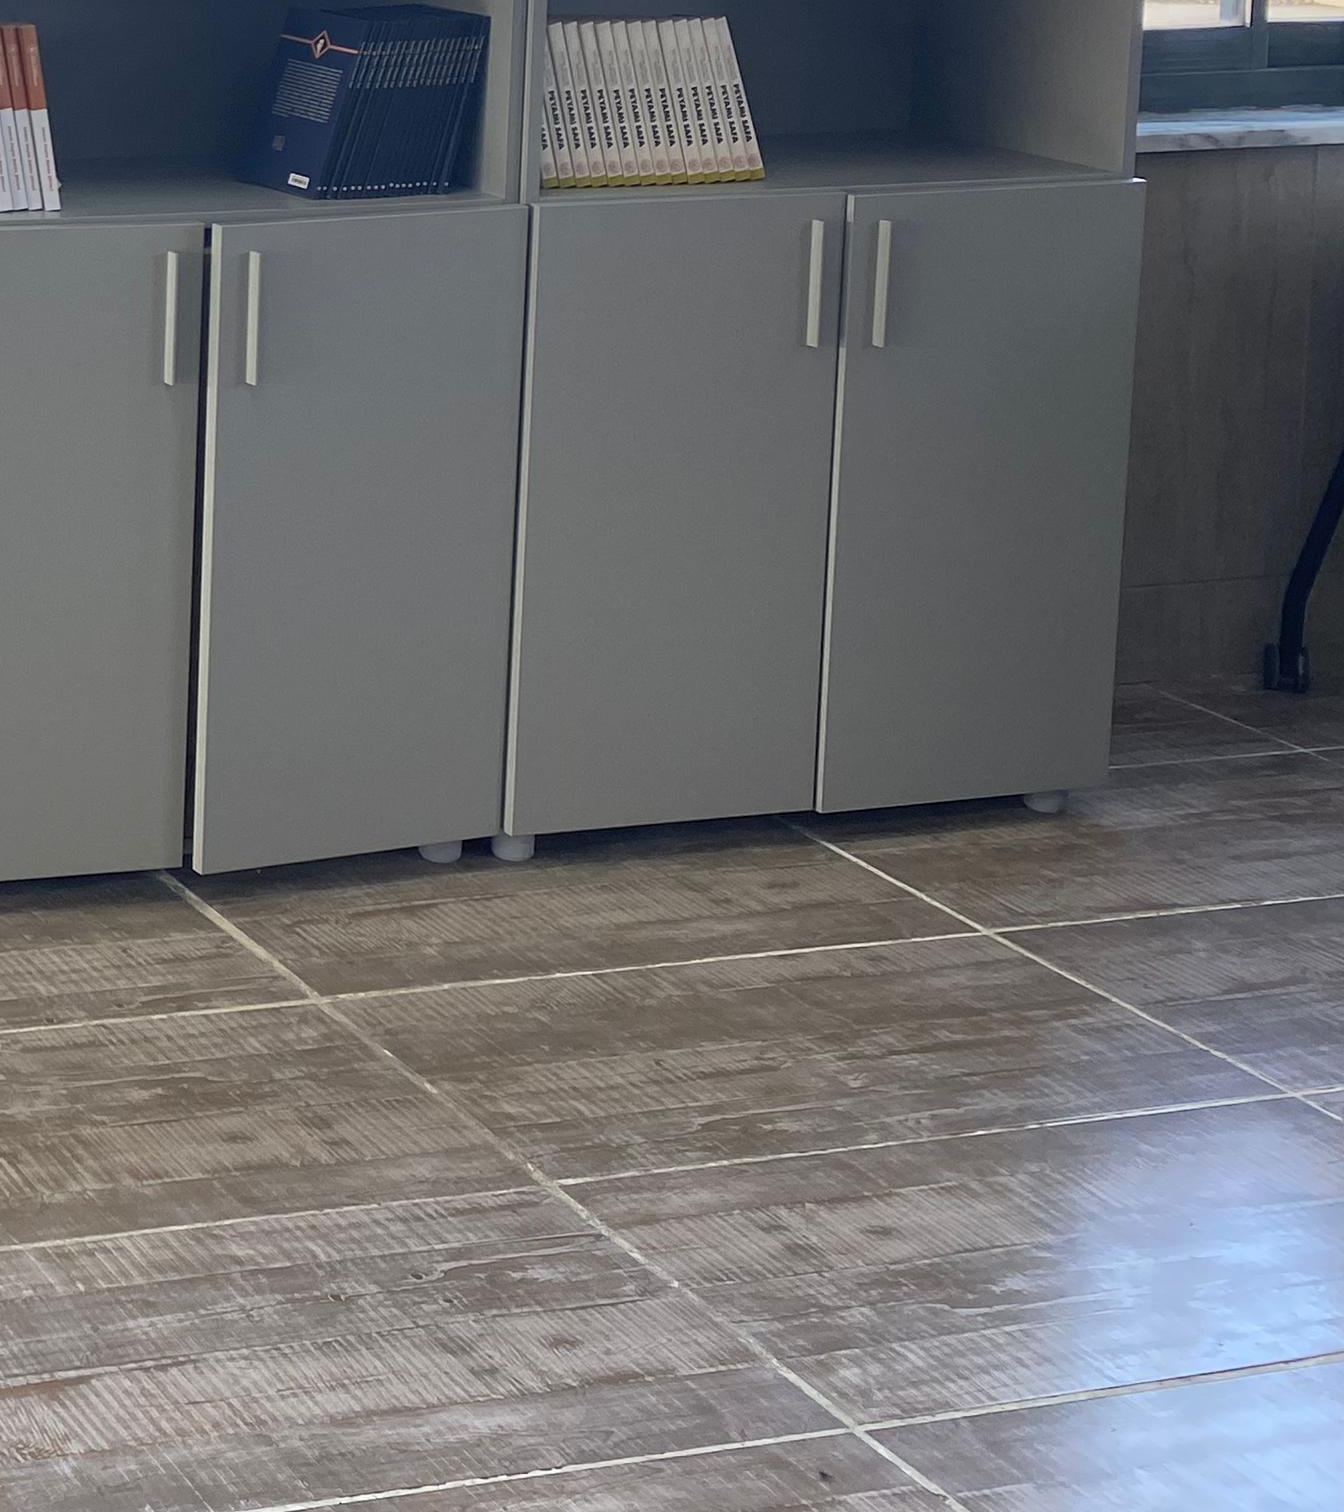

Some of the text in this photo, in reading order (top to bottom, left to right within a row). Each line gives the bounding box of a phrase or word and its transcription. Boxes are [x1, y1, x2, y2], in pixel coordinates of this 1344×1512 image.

[555, 127, 565, 150] SAFA
[571, 126, 581, 149] SAFA
[586, 125, 597, 148] SAFA
[603, 125, 613, 148] SAFA
[619, 125, 629, 148] SAFA
[635, 124, 645, 147] SAFA
[650, 124, 660, 147] SAFA
[665, 124, 676, 146] SAFA
[682, 123, 693, 146] SAFA
[698, 122, 708, 145] SAFA
[712, 121, 723, 144] SAFA
[727, 120, 738, 143] SAFA
[741, 119, 752, 142] SAFA
